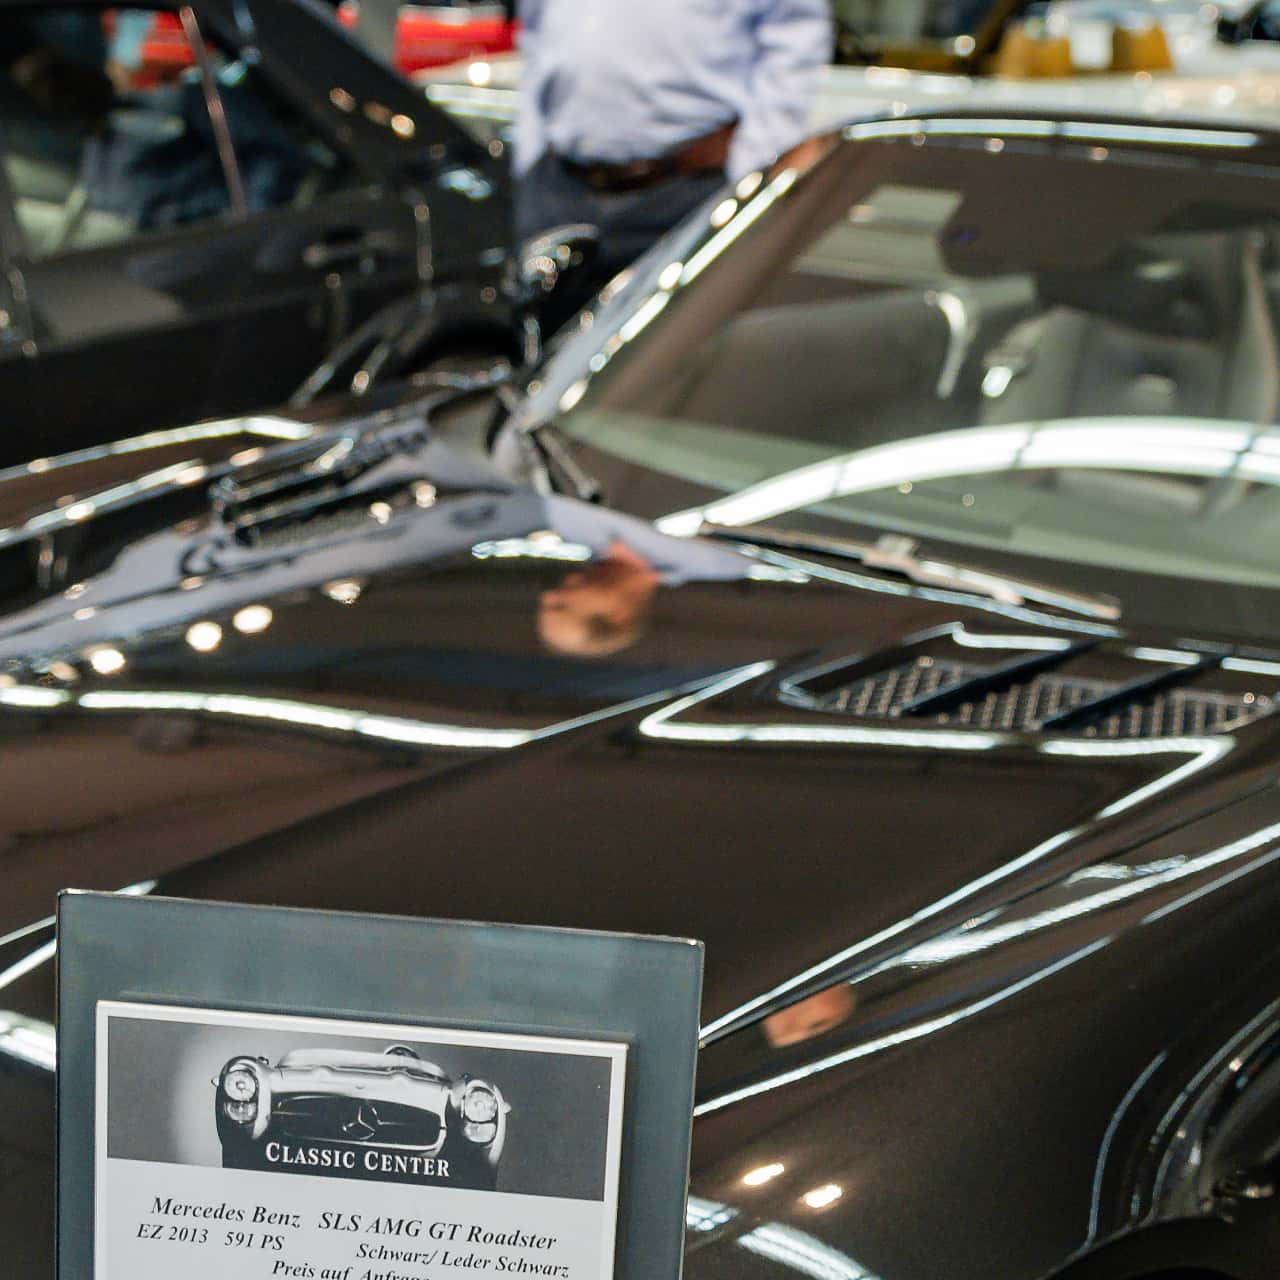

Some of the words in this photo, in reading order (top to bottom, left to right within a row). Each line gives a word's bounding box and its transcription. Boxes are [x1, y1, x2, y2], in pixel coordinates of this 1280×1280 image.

[265, 1141, 356, 1170] CLASSIC
[364, 1150, 450, 1178] CENTER
[151, 1197, 246, 1222] Mercedes
[252, 1206, 301, 1229] Benz
[318, 1211, 362, 1232] SLS
[365, 1217, 423, 1238] AMG
[428, 1222, 463, 1242] GT
[466, 1225, 558, 1250] Roadster
[137, 1223, 165, 1240] EZ
[167, 1225, 209, 1244] 2013
[224, 1231, 255, 1249] 591
[260, 1234, 286, 1251] PS
[356, 1243, 439, 1266] Schwarz/
[441, 1251, 492, 1270] Leder
[495, 1255, 570, 1279] Schwarz
[272, 1260, 315, 1278] Preis
